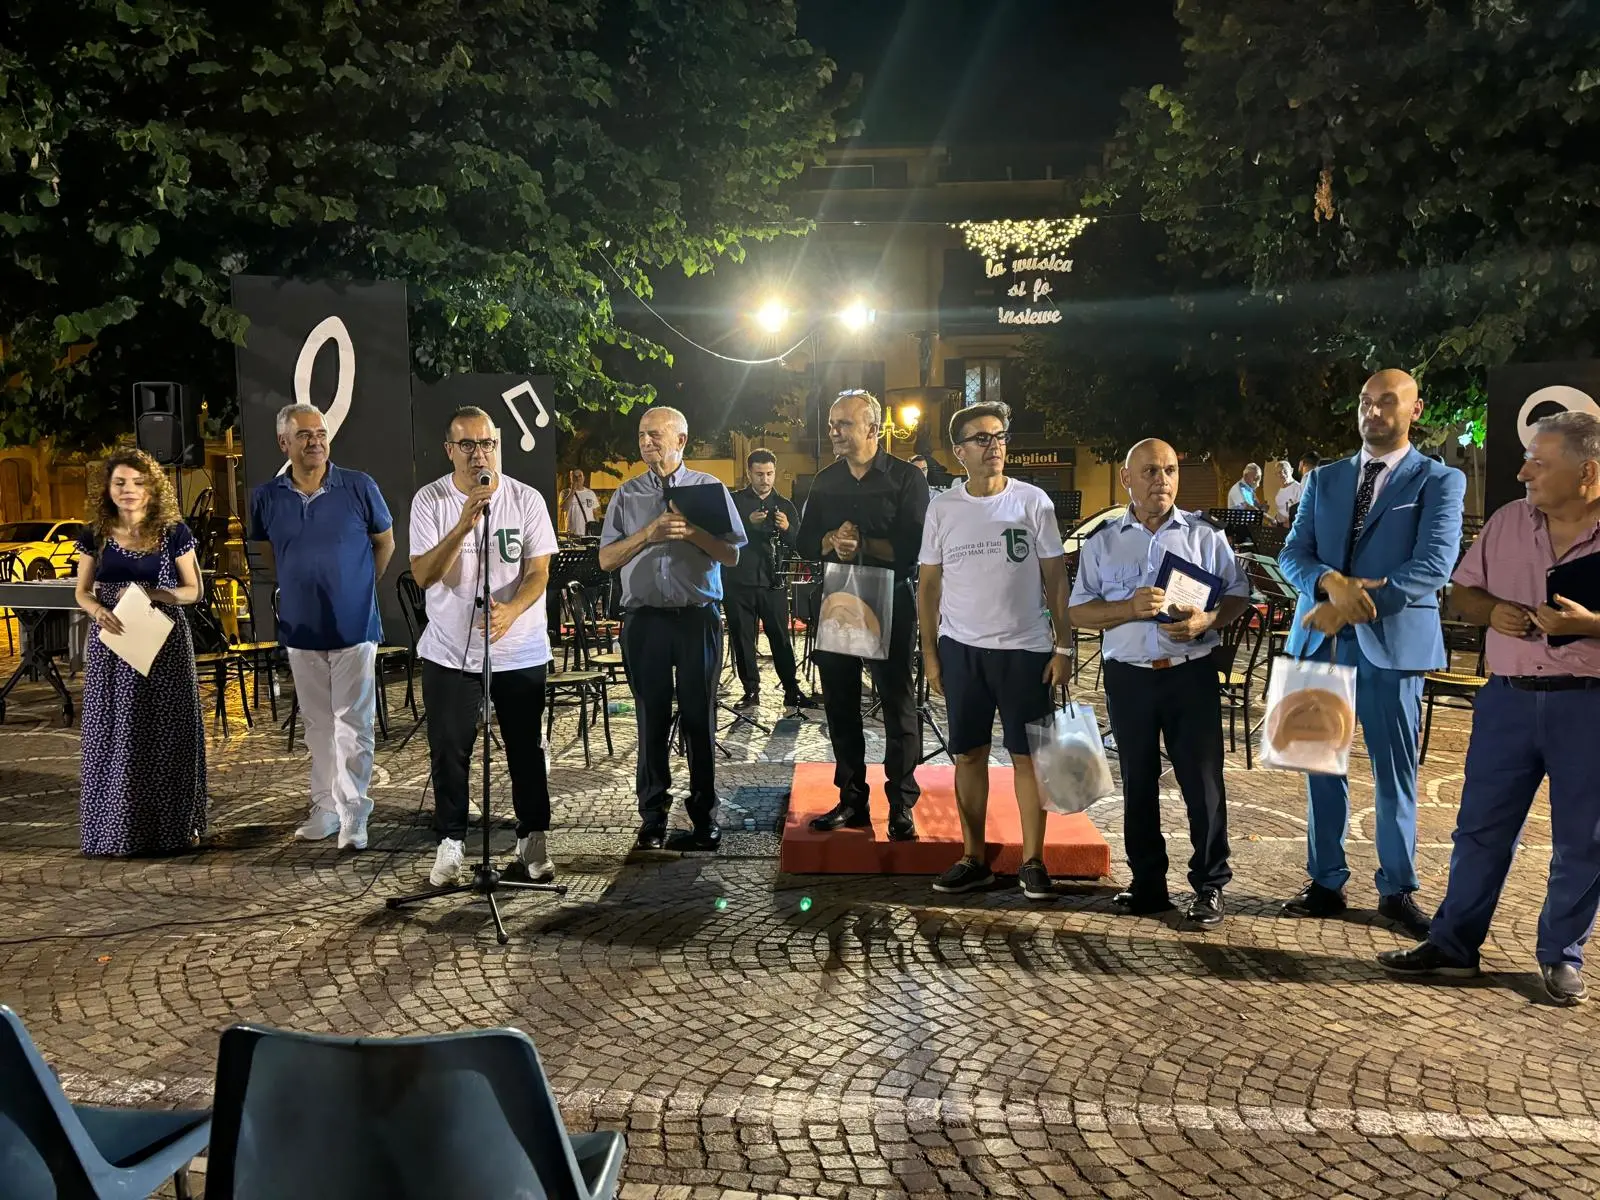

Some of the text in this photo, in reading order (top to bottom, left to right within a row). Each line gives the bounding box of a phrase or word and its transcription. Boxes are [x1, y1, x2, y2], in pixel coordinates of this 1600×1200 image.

[986, 253, 1073, 278] la musica
[1008, 281, 1026, 297] si
[1006, 452, 1058, 466] Gaglioti
[493, 528, 523, 563] 15
[1000, 528, 1029, 563] 15
